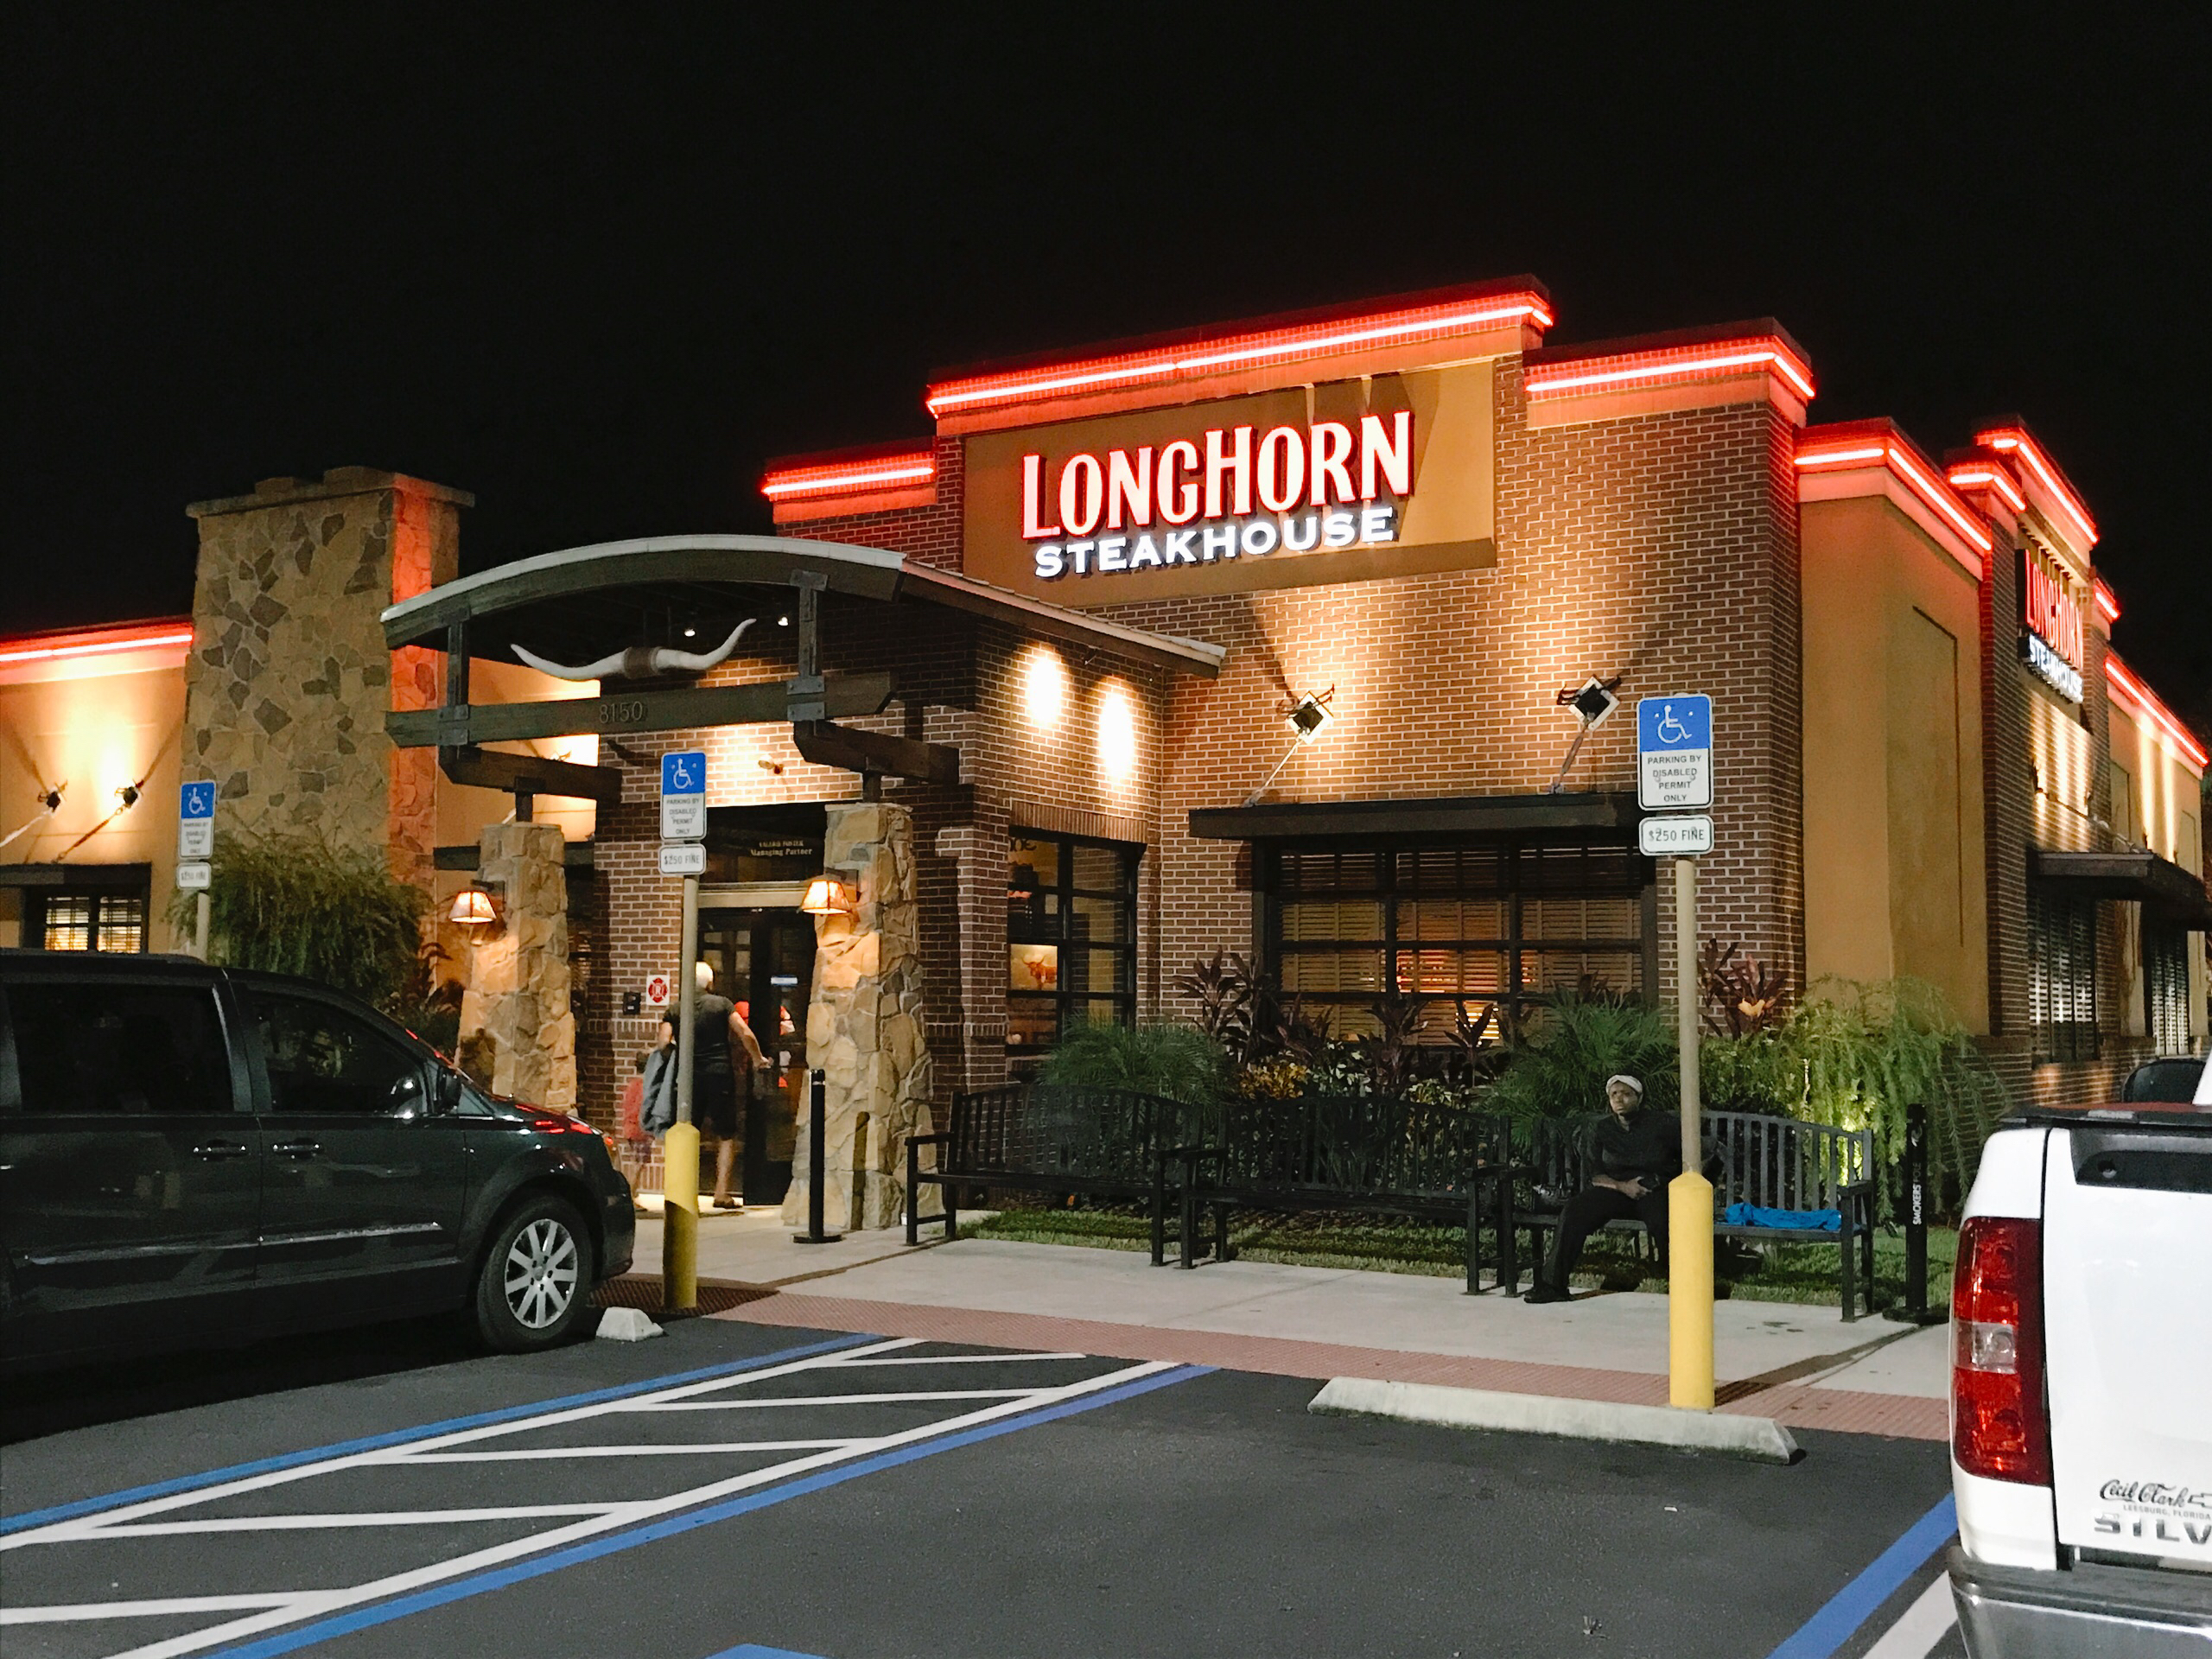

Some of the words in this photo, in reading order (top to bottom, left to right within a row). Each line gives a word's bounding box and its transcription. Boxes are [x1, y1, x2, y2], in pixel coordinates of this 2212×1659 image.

[1021, 410, 1412, 539] LONGHORN
[1035, 506, 1394, 578] STEAKHOUSE
[2025, 549, 2083, 672] LONGHORN
[2029, 632, 2083, 703] STEAKHOUSE
[600, 701, 643, 724] 8150
[1647, 756, 1687, 765] PARKING
[1689, 754, 1701, 763] BY
[1653, 768, 1697, 778] DISABLED
[1658, 780, 1691, 790] PERMIT
[1663, 794, 1687, 803] ONLY
[1649, 830, 1677, 842] $250
[1681, 829, 1704, 841] FINE
[664, 855, 683, 865] $250
[685, 854, 700, 864] FINE
[1912, 1183, 1922, 1225] SMOKERS
[2100, 1478, 2139, 1503] Cecil
[2138, 1482, 2189, 1508] Clark
[2122, 1504, 2171, 1516] LEESBURG,
[2173, 1509, 2211, 1521] FLORIDA
